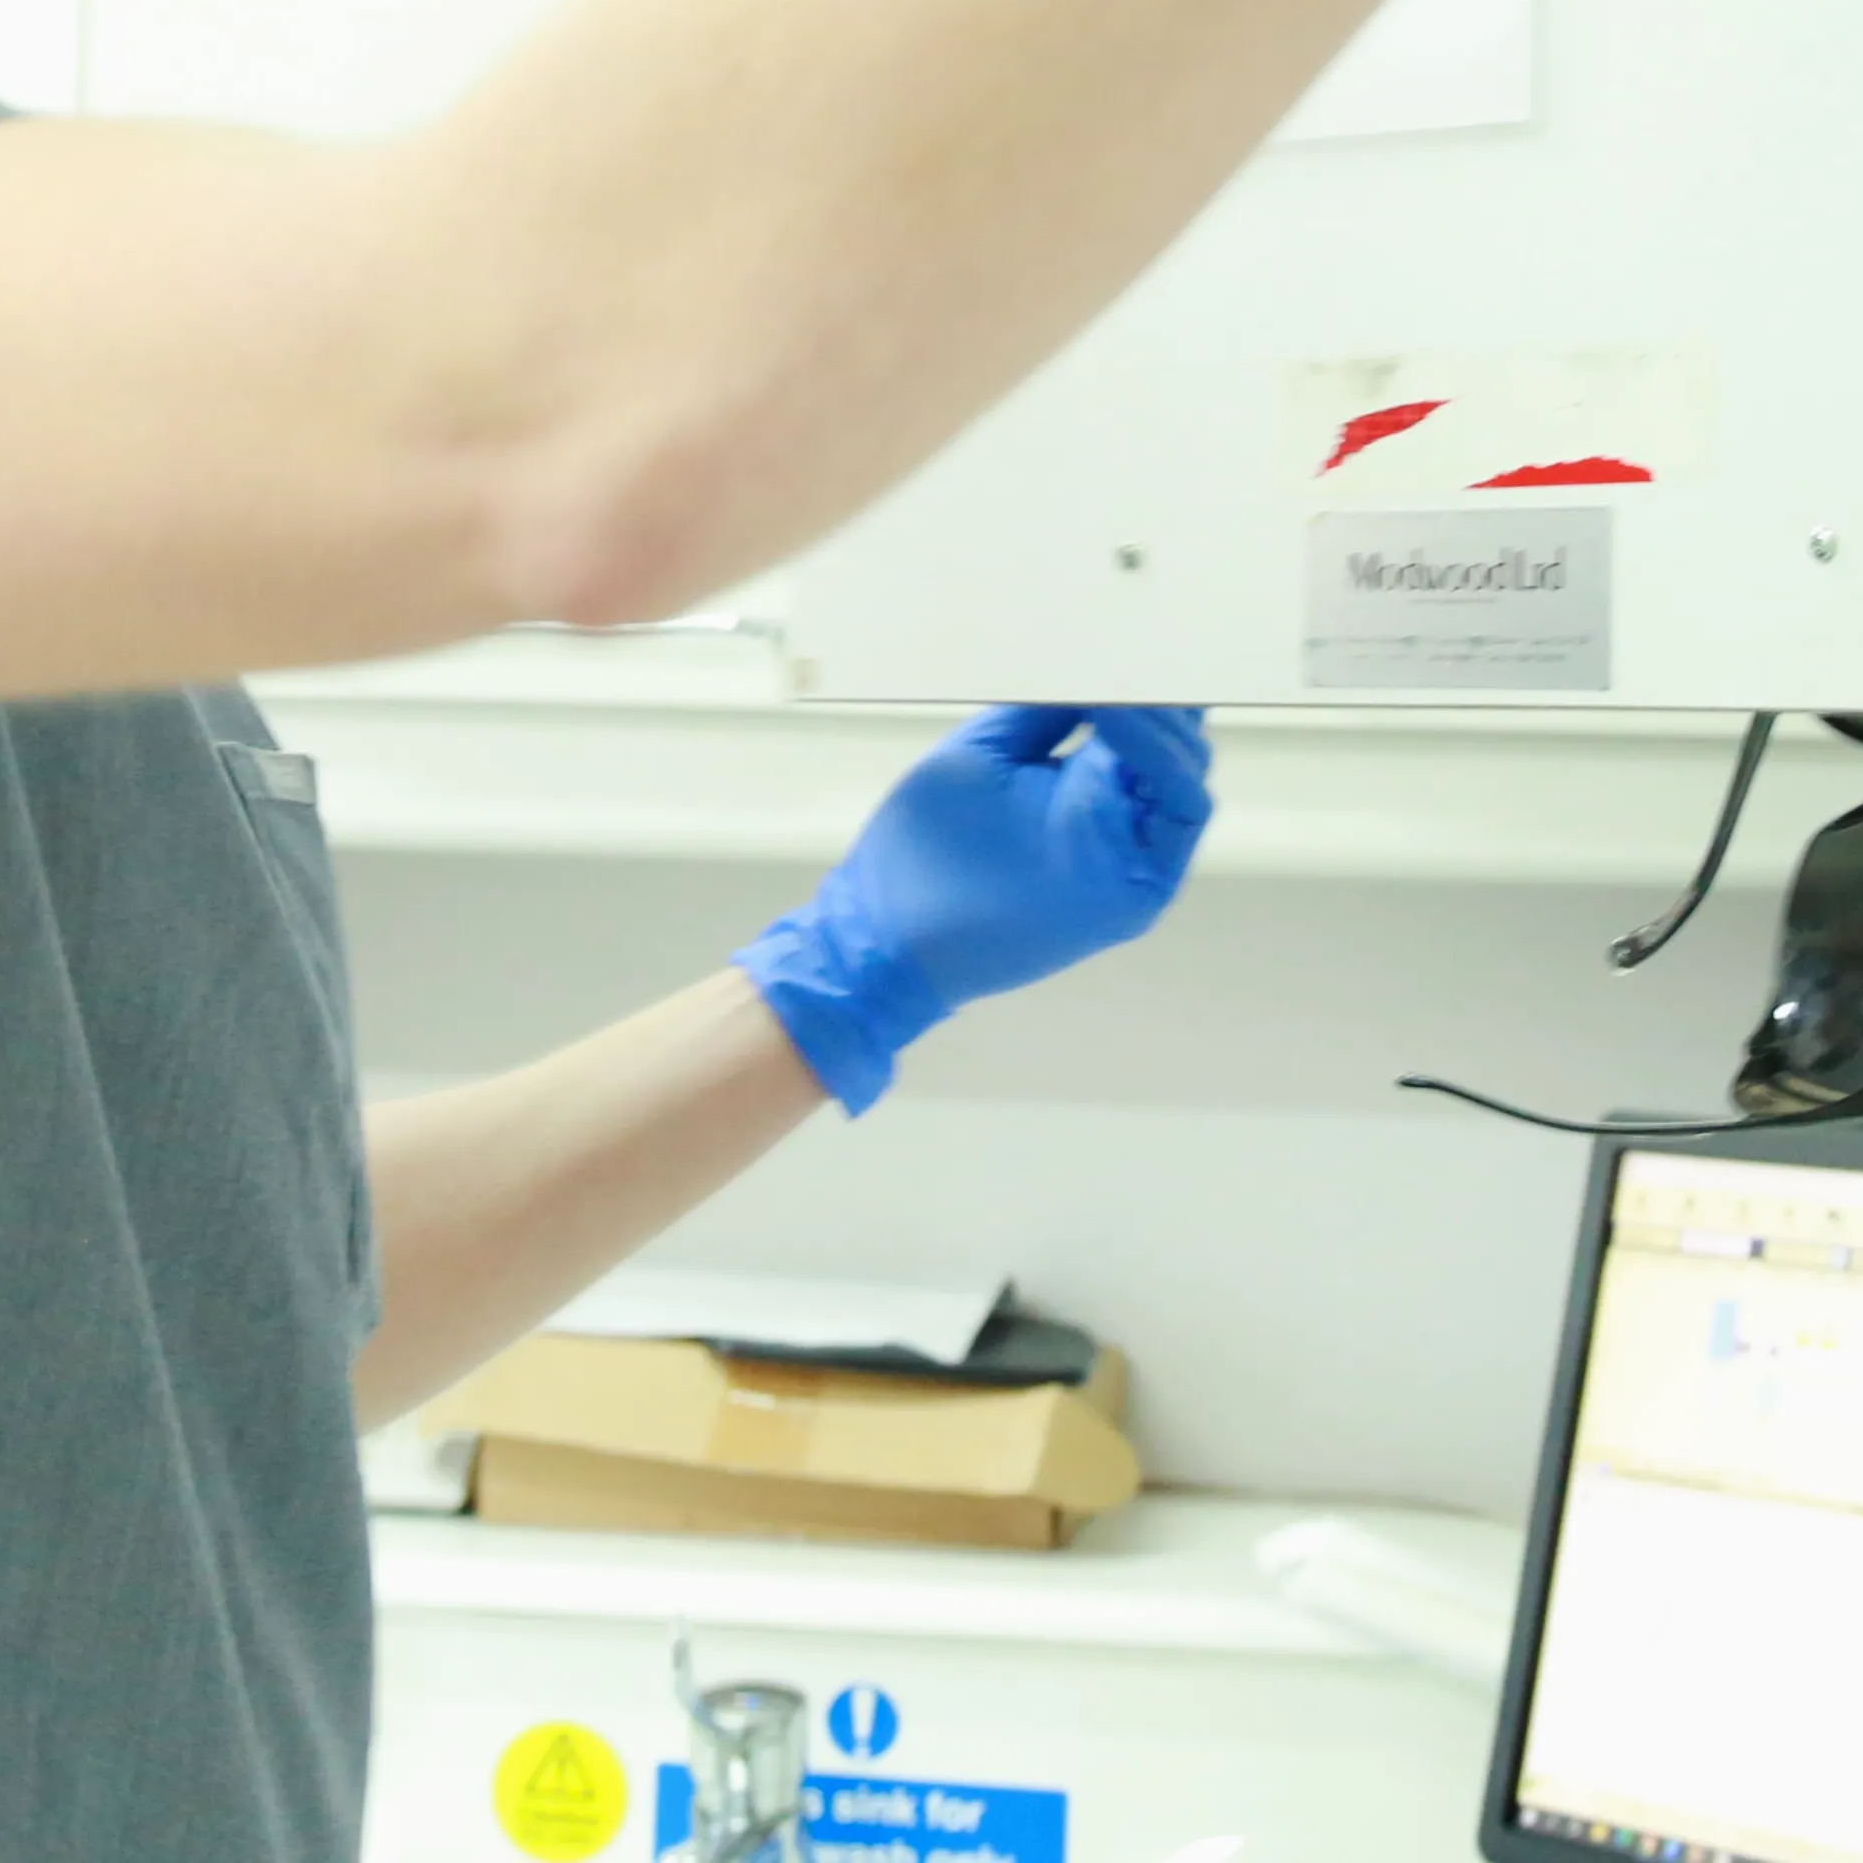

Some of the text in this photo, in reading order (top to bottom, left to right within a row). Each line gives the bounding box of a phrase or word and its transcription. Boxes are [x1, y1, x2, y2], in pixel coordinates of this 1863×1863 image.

[1514, 545, 1568, 591] Ltd
[831, 1782, 917, 1829] sink
[922, 1787, 986, 1834] for
